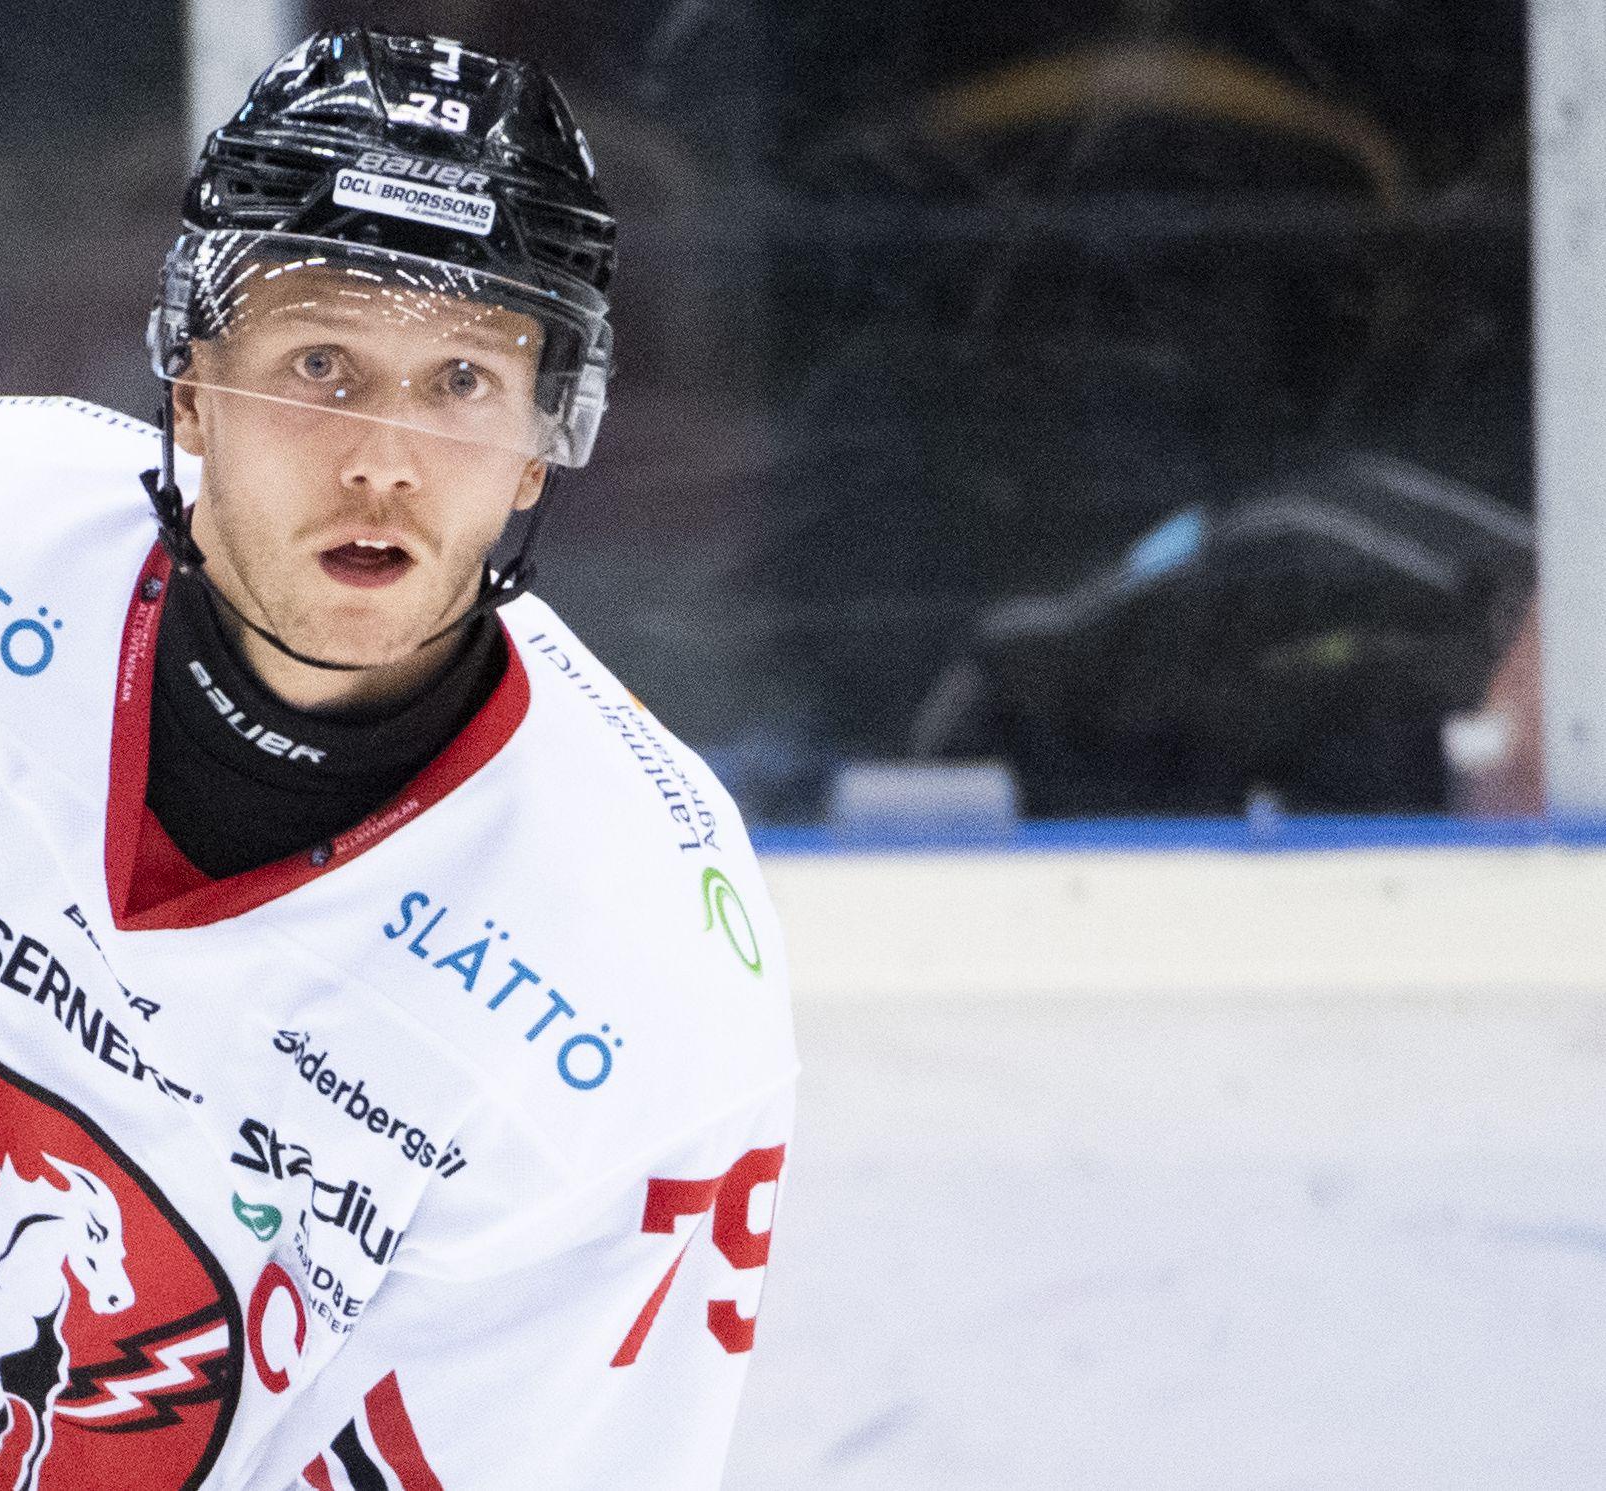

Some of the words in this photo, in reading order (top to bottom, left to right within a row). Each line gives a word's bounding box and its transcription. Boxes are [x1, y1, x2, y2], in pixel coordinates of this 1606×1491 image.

[405, 92, 470, 133] 79
[382, 891, 623, 1091] SLÄTTÖ
[247, 1260, 307, 1395] C
[609, 1143, 783, 1368] 79
